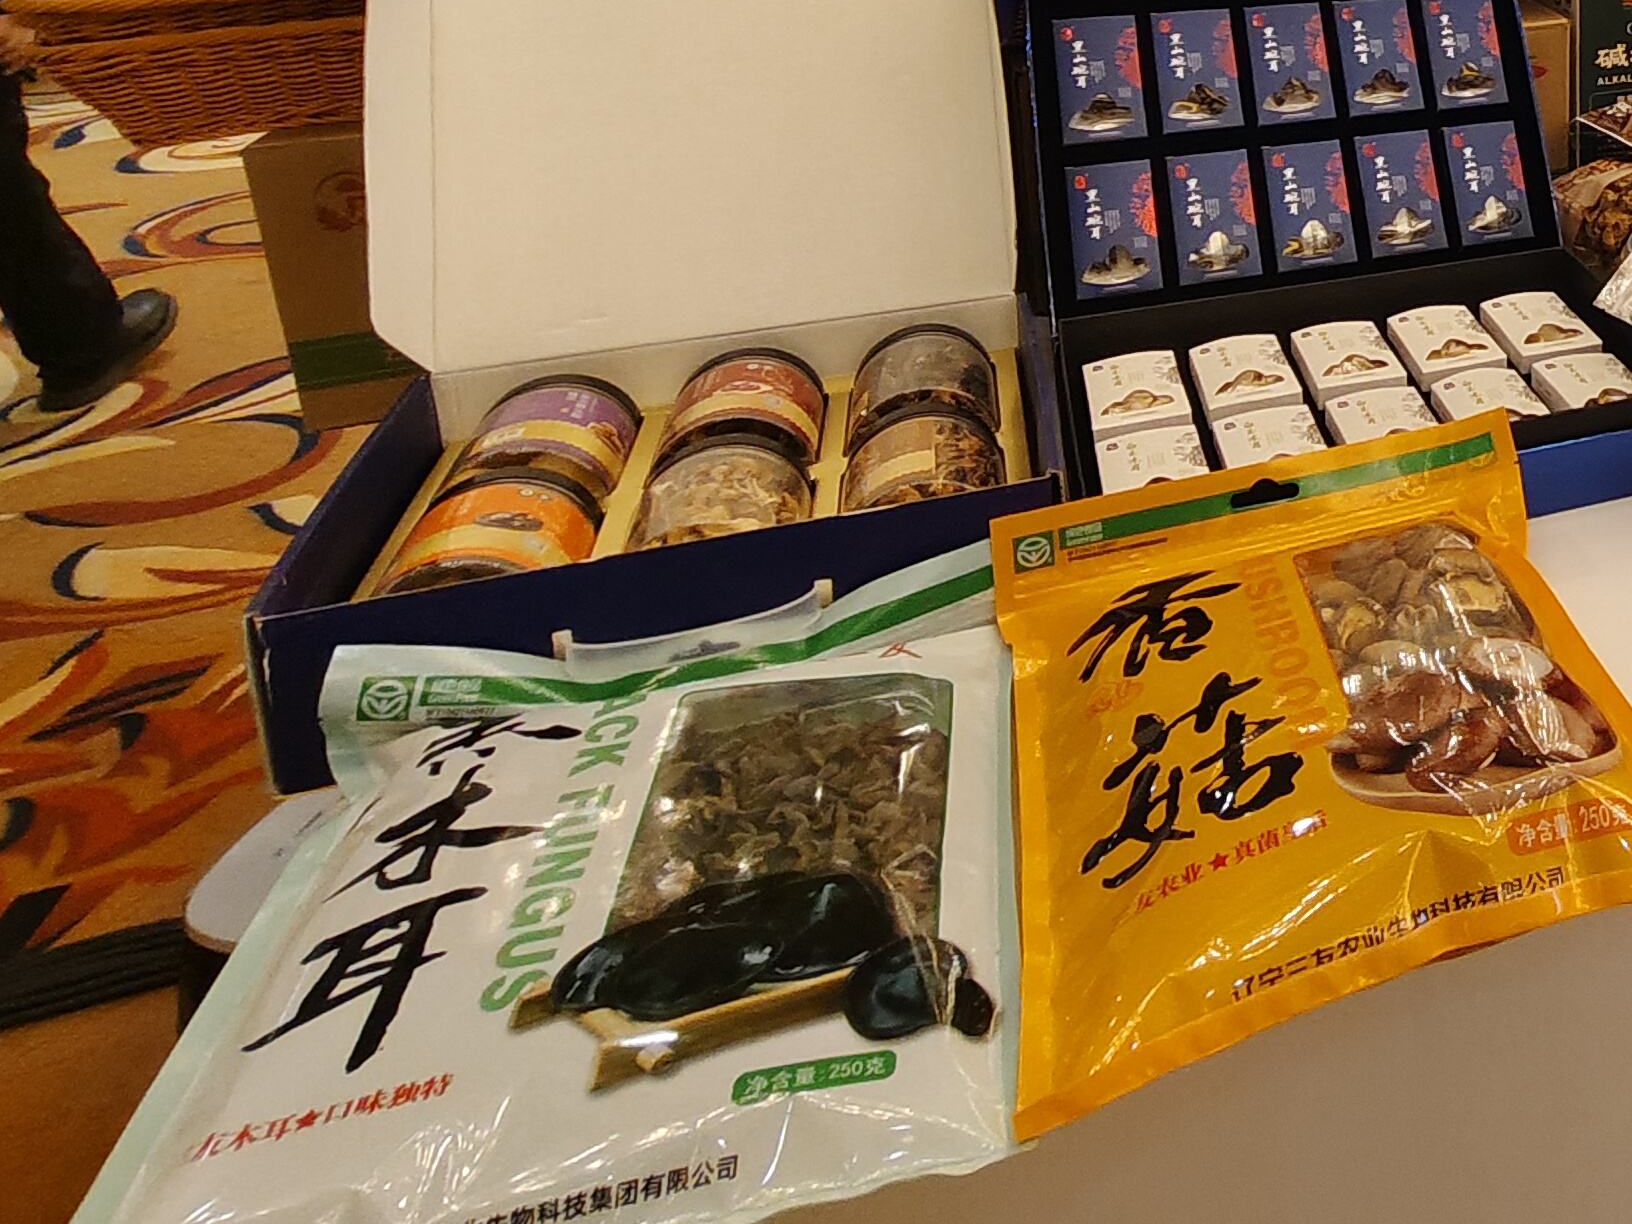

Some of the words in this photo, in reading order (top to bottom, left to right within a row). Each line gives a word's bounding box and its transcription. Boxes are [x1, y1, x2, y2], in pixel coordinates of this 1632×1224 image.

[1066, 569, 1304, 889] 香菇
[479, 784, 614, 1011] FUNGUS
[322, 1073, 453, 1126] 口味独特
